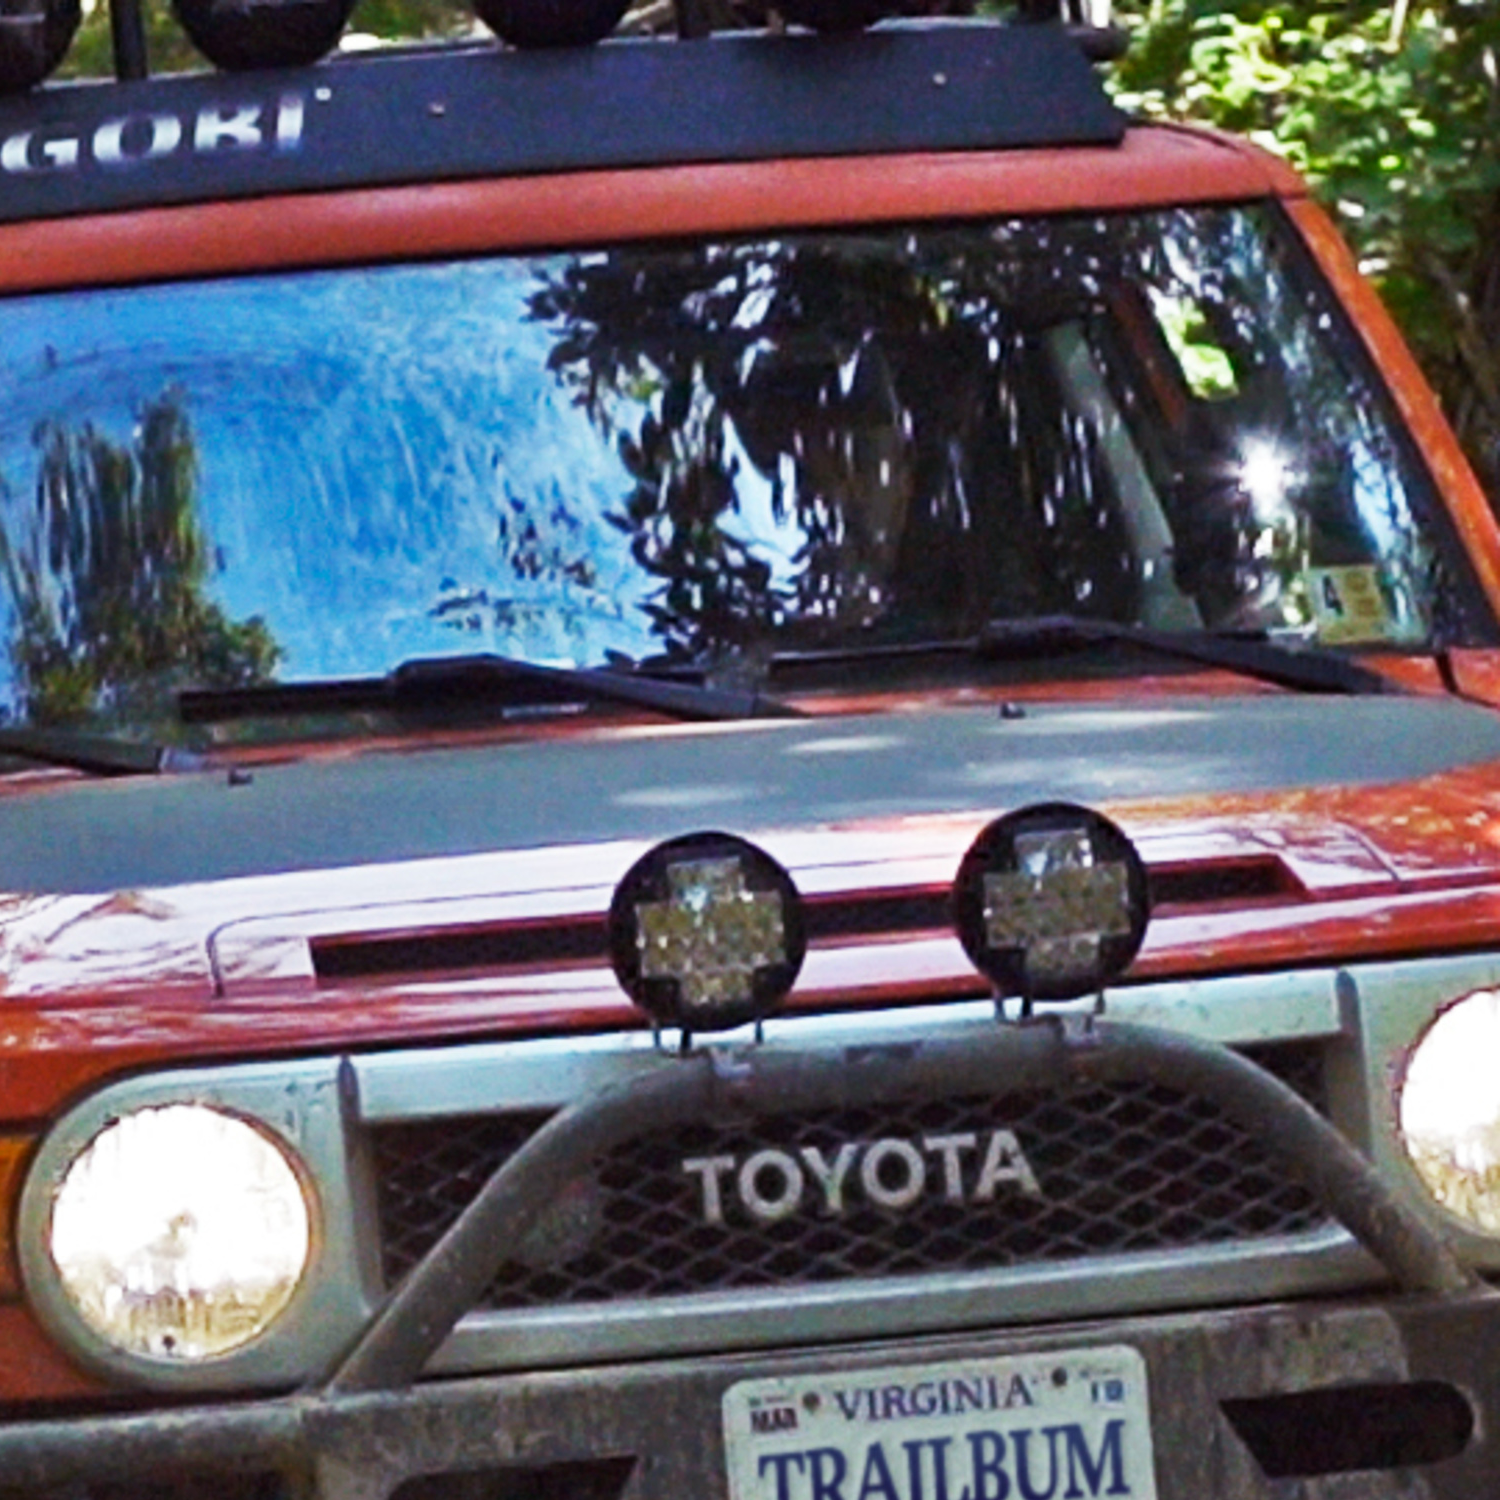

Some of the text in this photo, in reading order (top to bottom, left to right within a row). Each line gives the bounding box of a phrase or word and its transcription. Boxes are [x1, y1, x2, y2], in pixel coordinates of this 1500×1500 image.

[0, 95, 304, 173] GOBI
[682, 1129, 1042, 1224] TOYOTA
[834, 1373, 1034, 1421] VIRGINIA
